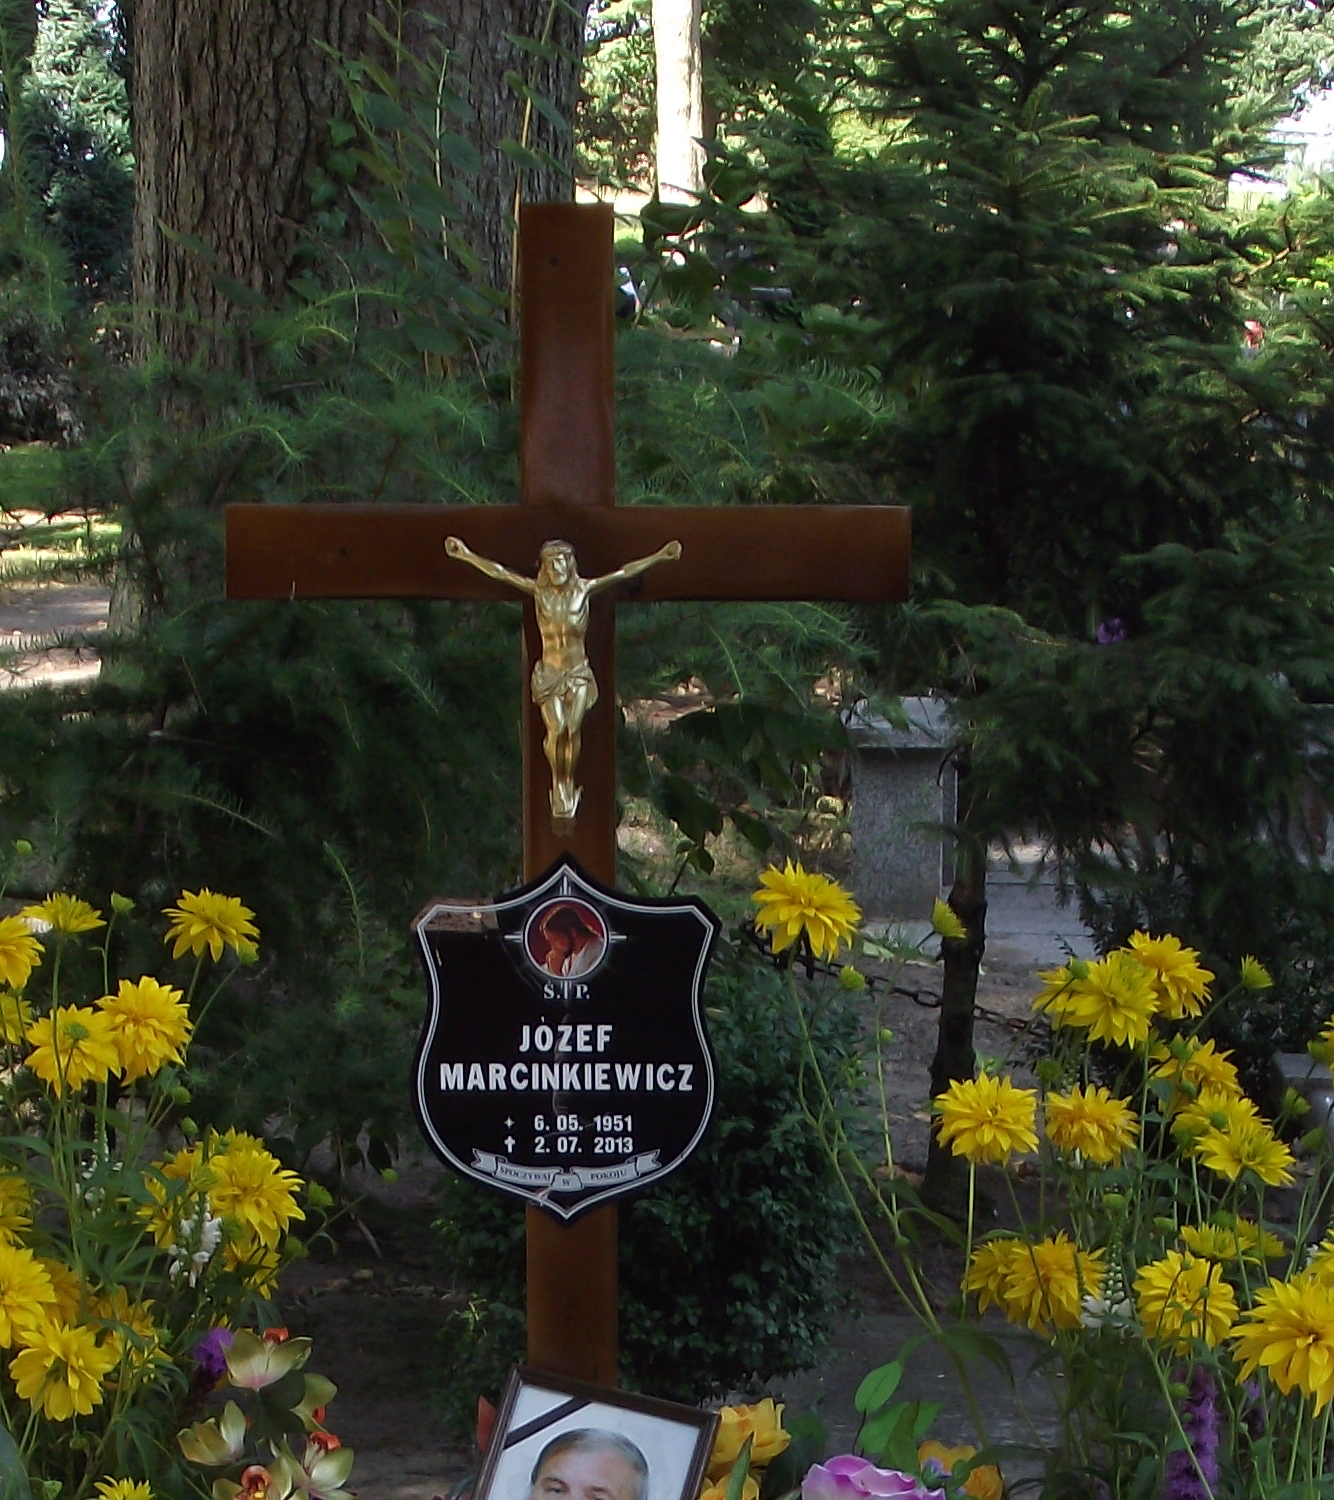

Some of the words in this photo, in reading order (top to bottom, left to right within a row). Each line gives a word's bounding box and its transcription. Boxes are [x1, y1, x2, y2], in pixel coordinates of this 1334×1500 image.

[519, 1016, 613, 1053] JÓZEF
[439, 1062, 695, 1092] MARCINKIEWICZ
[593, 1115, 634, 1132] 1951
[593, 1136, 634, 1154] 2013
